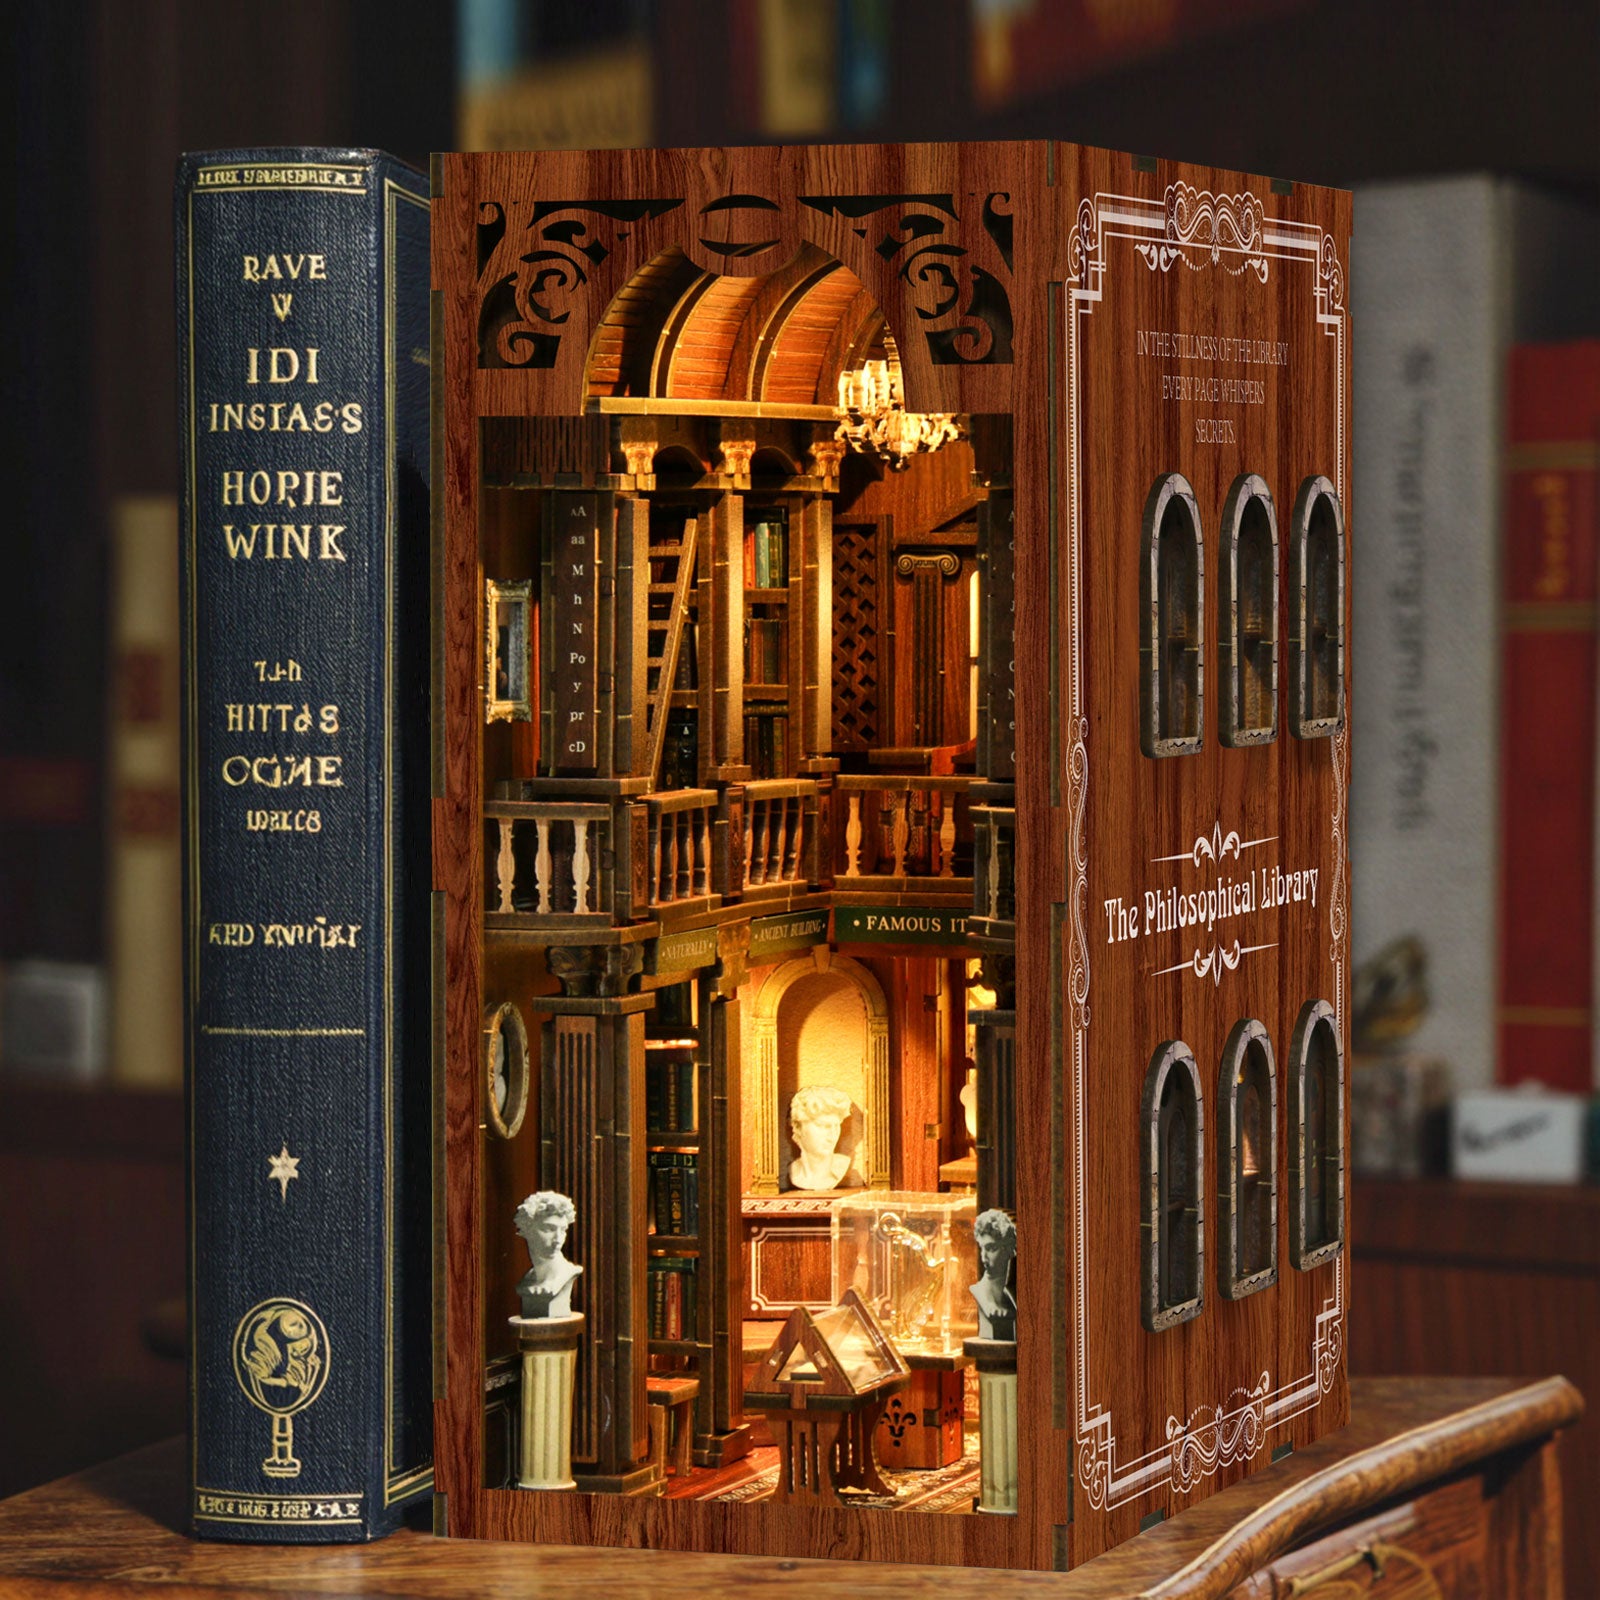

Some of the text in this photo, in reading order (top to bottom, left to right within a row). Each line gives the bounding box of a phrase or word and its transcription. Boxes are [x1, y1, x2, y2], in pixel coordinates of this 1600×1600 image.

[243, 254, 327, 283] RAVE
[1137, 331, 1289, 366] IN THE STILLNESS OF THE LIBRARY
[247, 348, 320, 384] IDI
[1163, 375, 1265, 405] EVERY PAGE WHISPERS
[222, 524, 347, 562] WINK
[572, 565, 584, 576] M
[574, 595, 582, 605] h
[573, 624, 582, 634] N
[570, 653, 586, 664] Po
[1104, 865, 1319, 944] The Philosophical Library
[866, 915, 942, 933] FAMOUS
